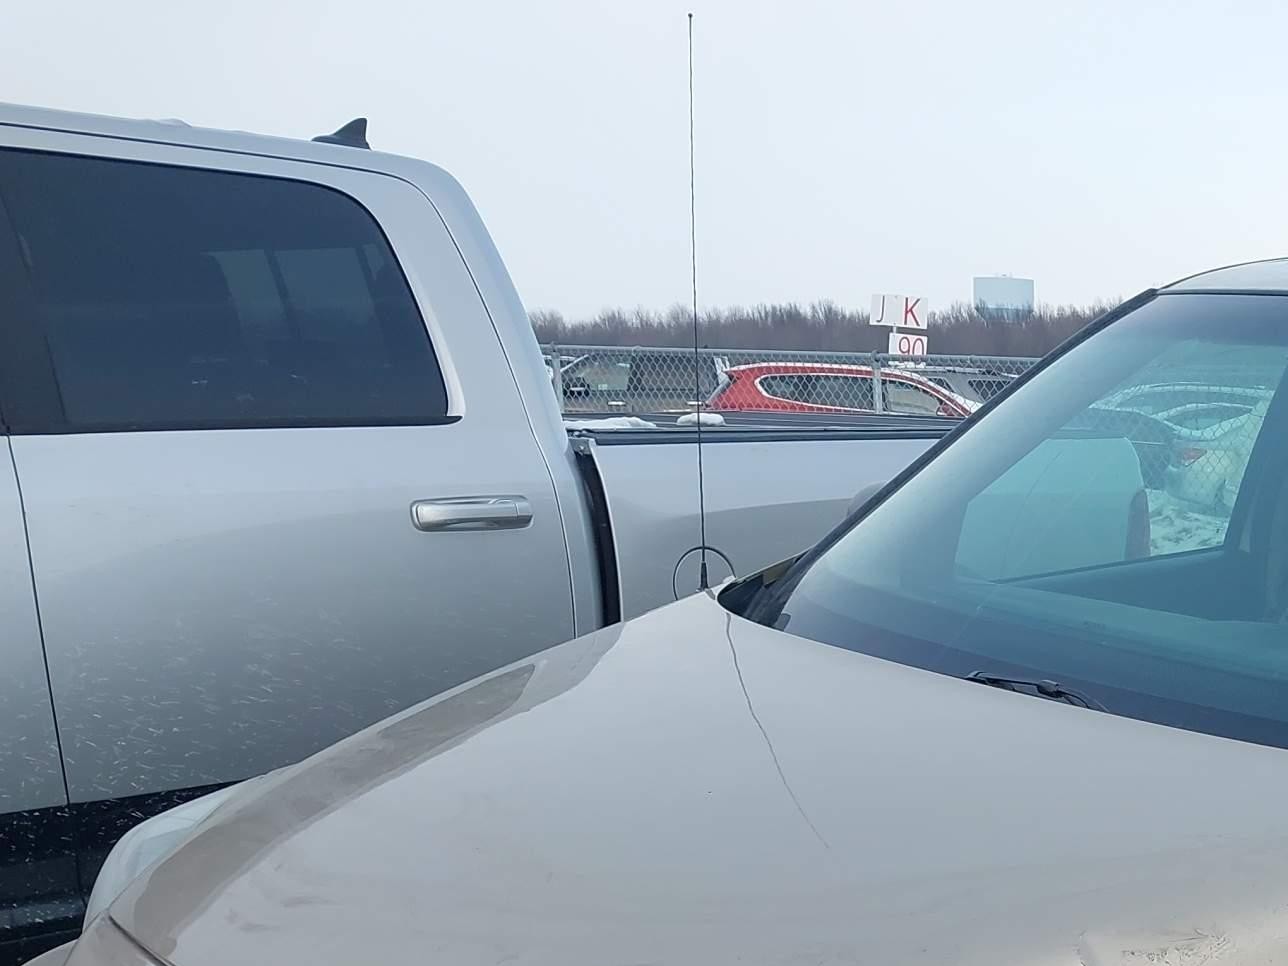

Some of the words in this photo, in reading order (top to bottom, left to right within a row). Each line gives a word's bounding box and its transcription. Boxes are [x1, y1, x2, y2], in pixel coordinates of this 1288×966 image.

[876, 295, 885, 323] J
[904, 297, 921, 327] K
[898, 336, 925, 355] 90
